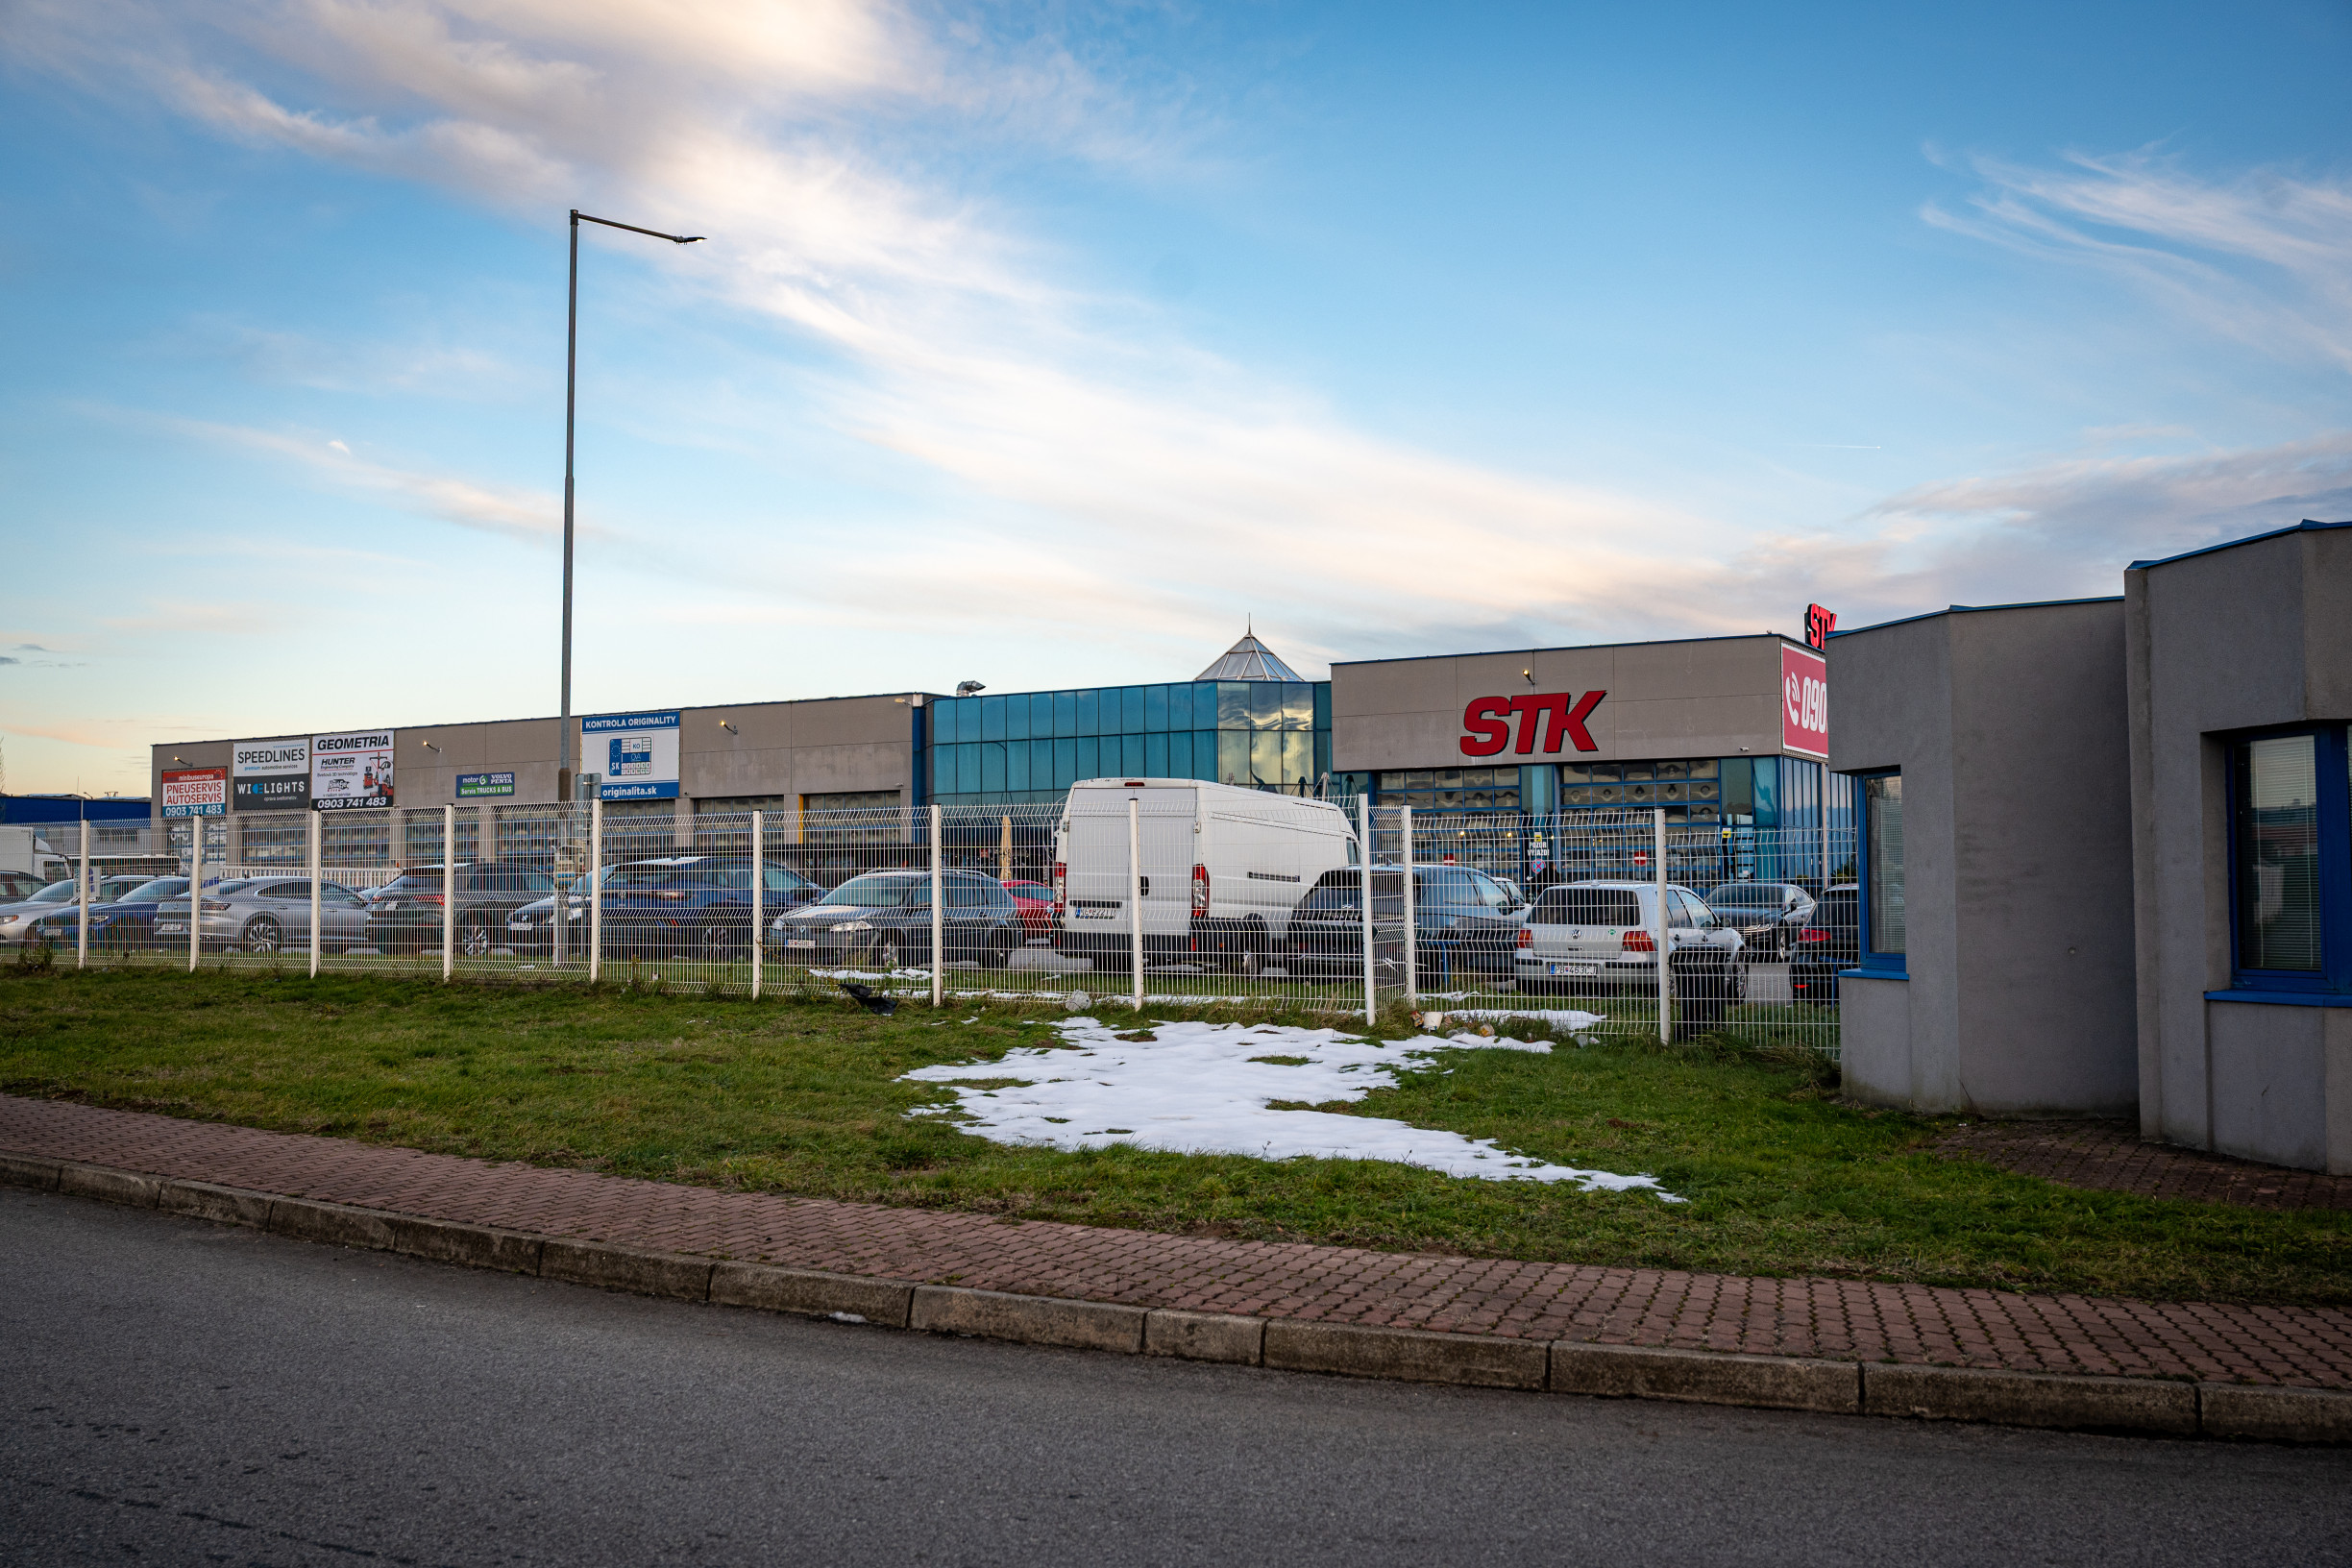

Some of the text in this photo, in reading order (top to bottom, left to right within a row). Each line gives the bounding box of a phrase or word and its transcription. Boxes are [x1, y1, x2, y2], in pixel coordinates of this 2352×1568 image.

[585, 716, 676, 729] KONTROLA ORIGINALITY
[1459, 690, 1607, 757] STK
[317, 735, 389, 750] GEOMETRIA
[237, 748, 306, 764] SPEEDLINES
[321, 757, 355, 766] HUNTER
[611, 762, 620, 771] SK
[178, 773, 214, 782] minibuseuropa
[166, 782, 222, 795] PNEUSERVIS
[602, 786, 657, 798] originalita.sk
[166, 793, 222, 805] AUTOSERVIS
[317, 796, 387, 809] 0903 741 483
[165, 804, 222, 817] 0903 741 483
